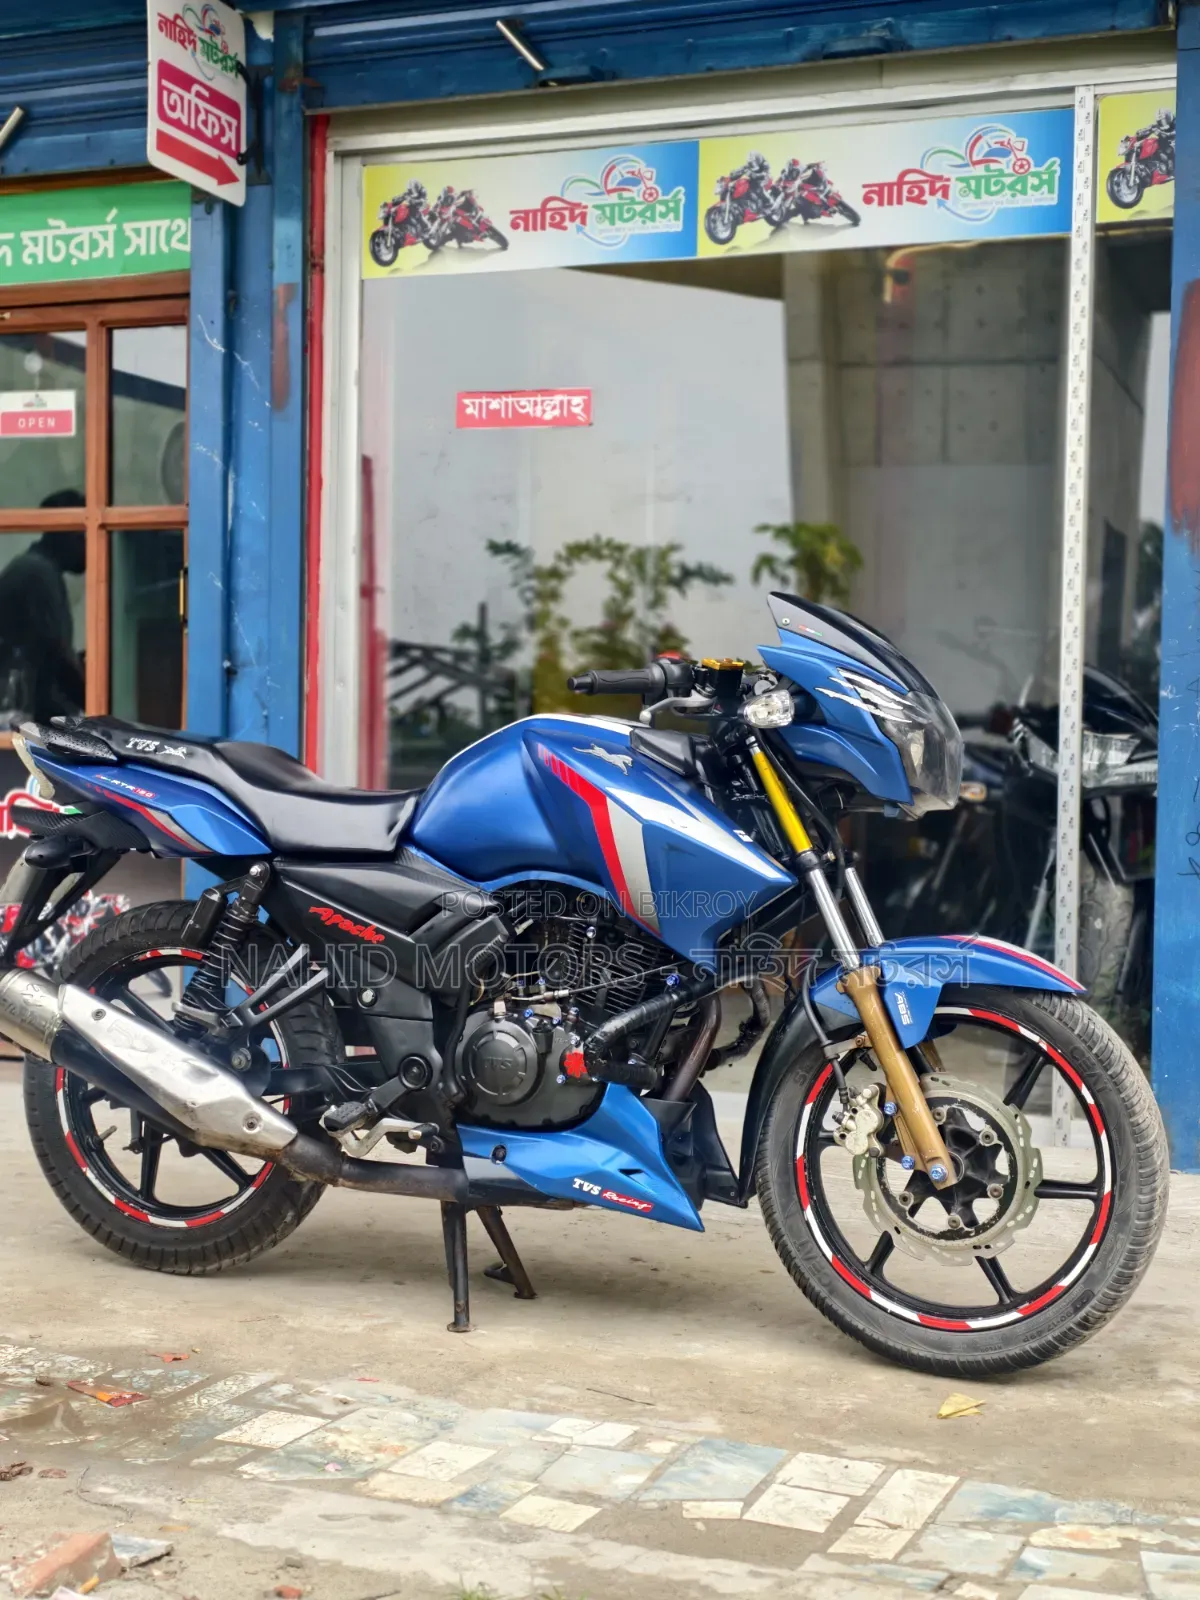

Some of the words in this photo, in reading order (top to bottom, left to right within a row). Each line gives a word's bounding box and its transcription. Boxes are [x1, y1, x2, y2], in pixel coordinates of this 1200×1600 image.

[157, 12, 197, 53] নাহিদ
[161, 79, 237, 151] অফিস
[862, 169, 950, 206] নাহিদ
[509, 196, 588, 232] নাহিদ
[18, 416, 55, 429] OPEN
[125, 737, 160, 751] TVS
[309, 907, 385, 944] Apache
[894, 992, 910, 1025] ABS
[572, 1178, 602, 1196] TVS
[603, 1191, 652, 1210] Racing
